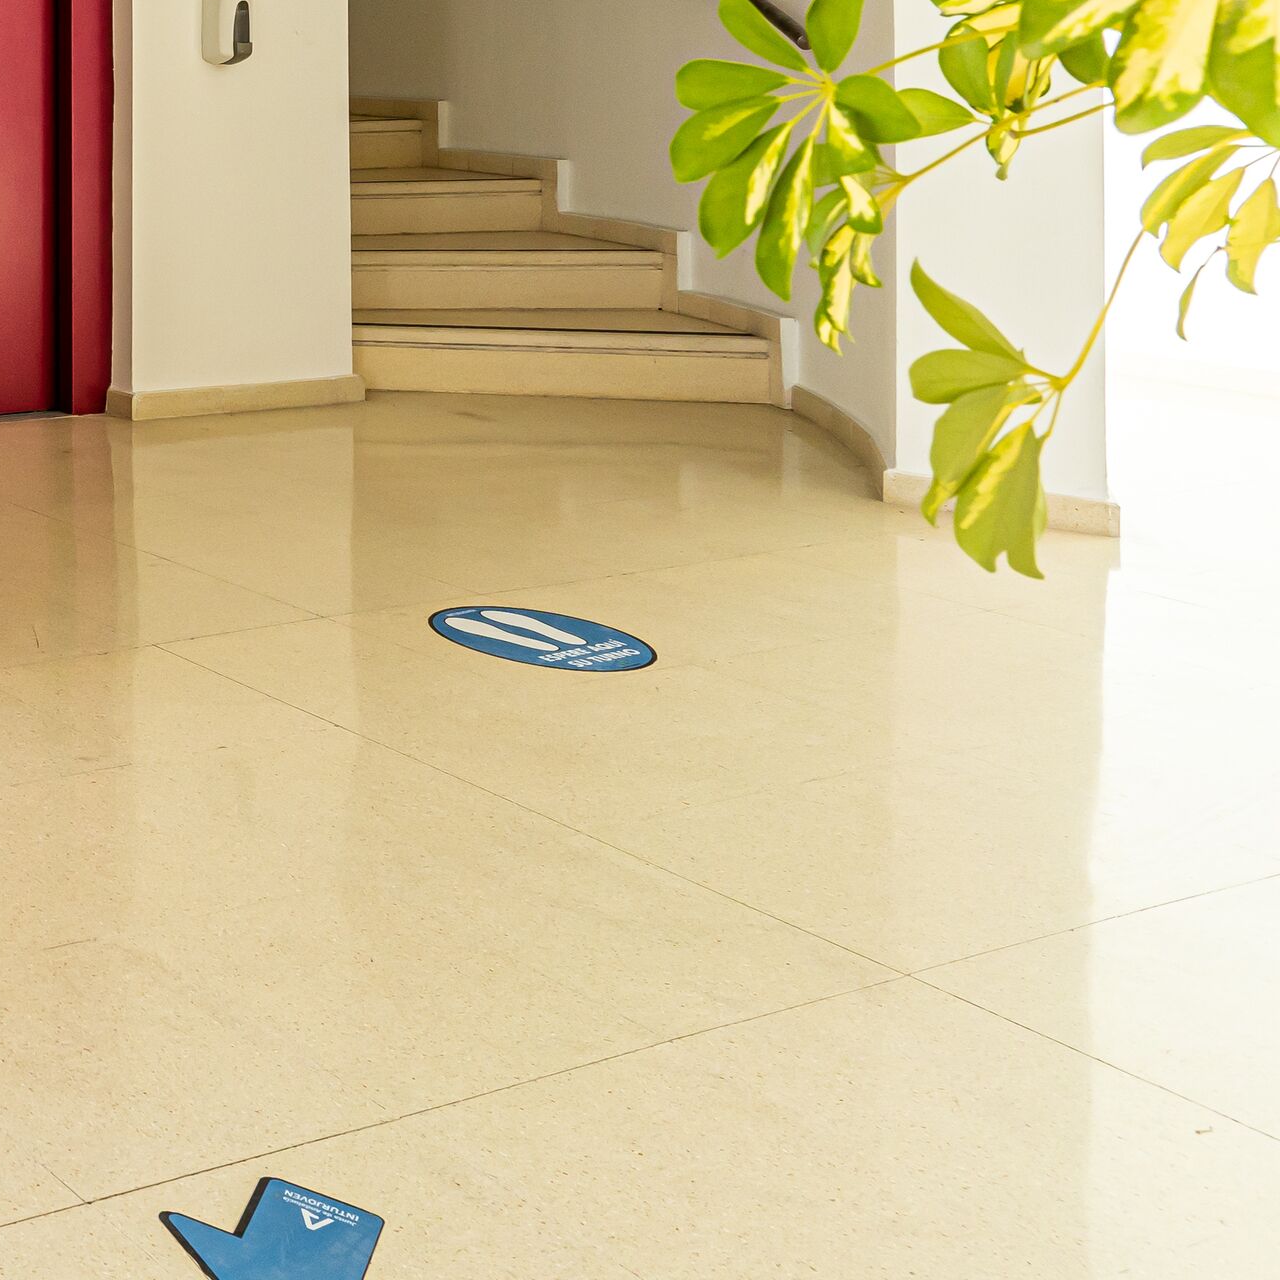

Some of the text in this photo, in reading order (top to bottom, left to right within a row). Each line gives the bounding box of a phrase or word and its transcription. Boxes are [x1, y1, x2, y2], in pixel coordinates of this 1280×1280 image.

[538, 648, 592, 662] ESPERE
[567, 648, 641, 668] SU TURNO
[284, 1190, 359, 1221] INTURJOVEN
[334, 1215, 357, 1226] Junta
